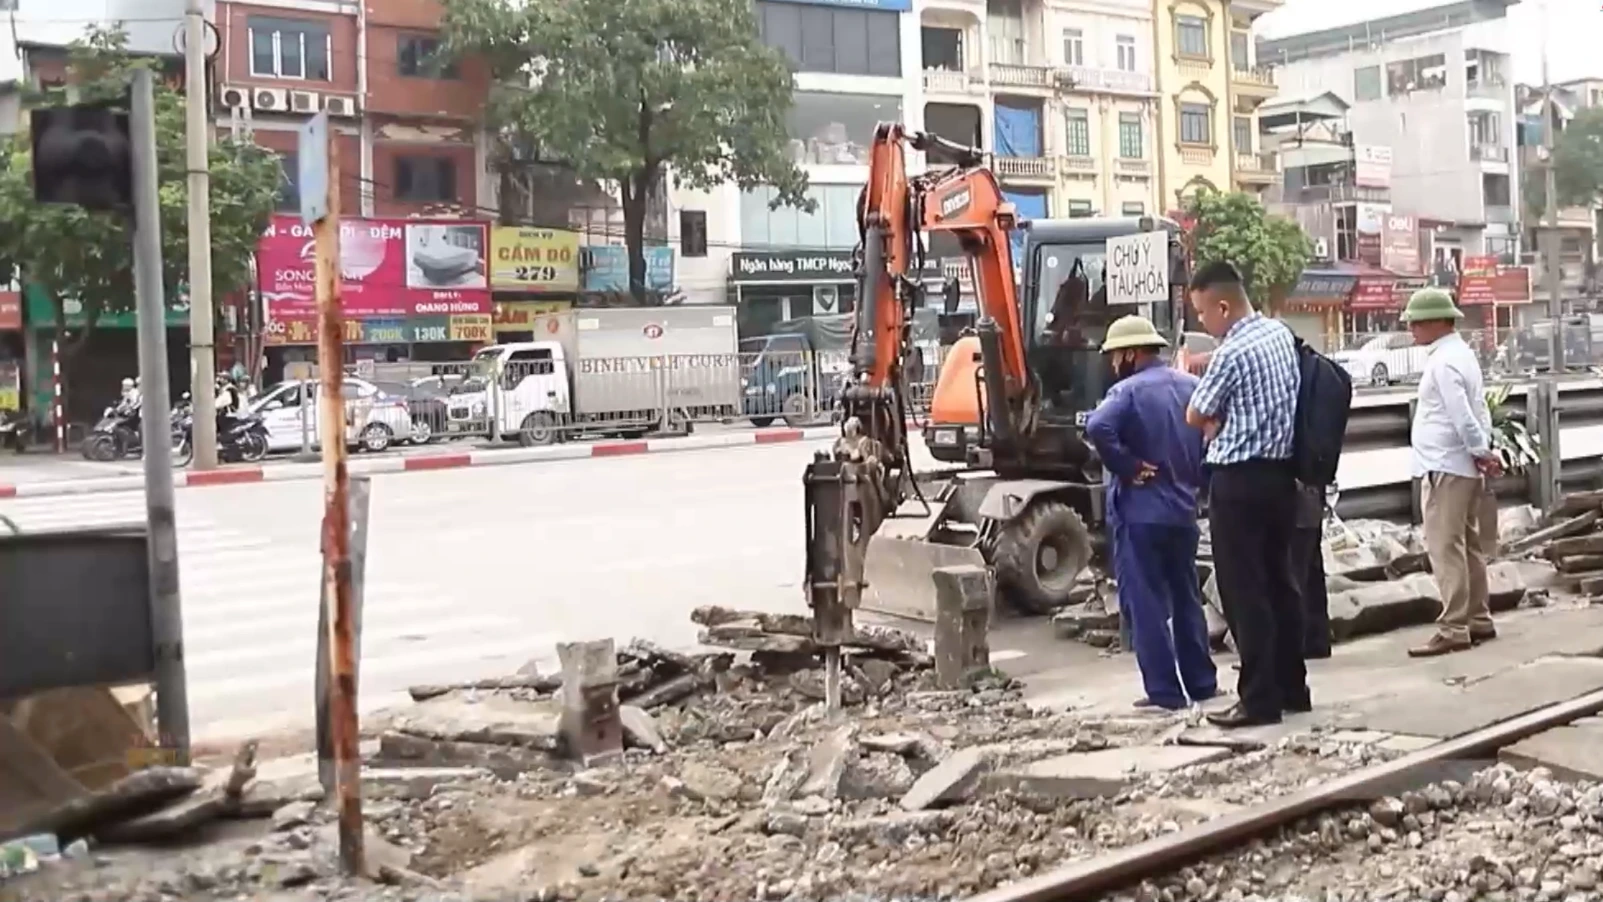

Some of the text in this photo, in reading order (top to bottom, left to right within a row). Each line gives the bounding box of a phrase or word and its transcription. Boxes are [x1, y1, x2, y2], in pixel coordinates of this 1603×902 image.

[740, 257, 767, 274] Ngân
[769, 257, 794, 273] hàng
[795, 257, 827, 270] TMCP
[515, 266, 557, 281] 279
[414, 326, 446, 341] 130K
[636, 354, 679, 370] VH
